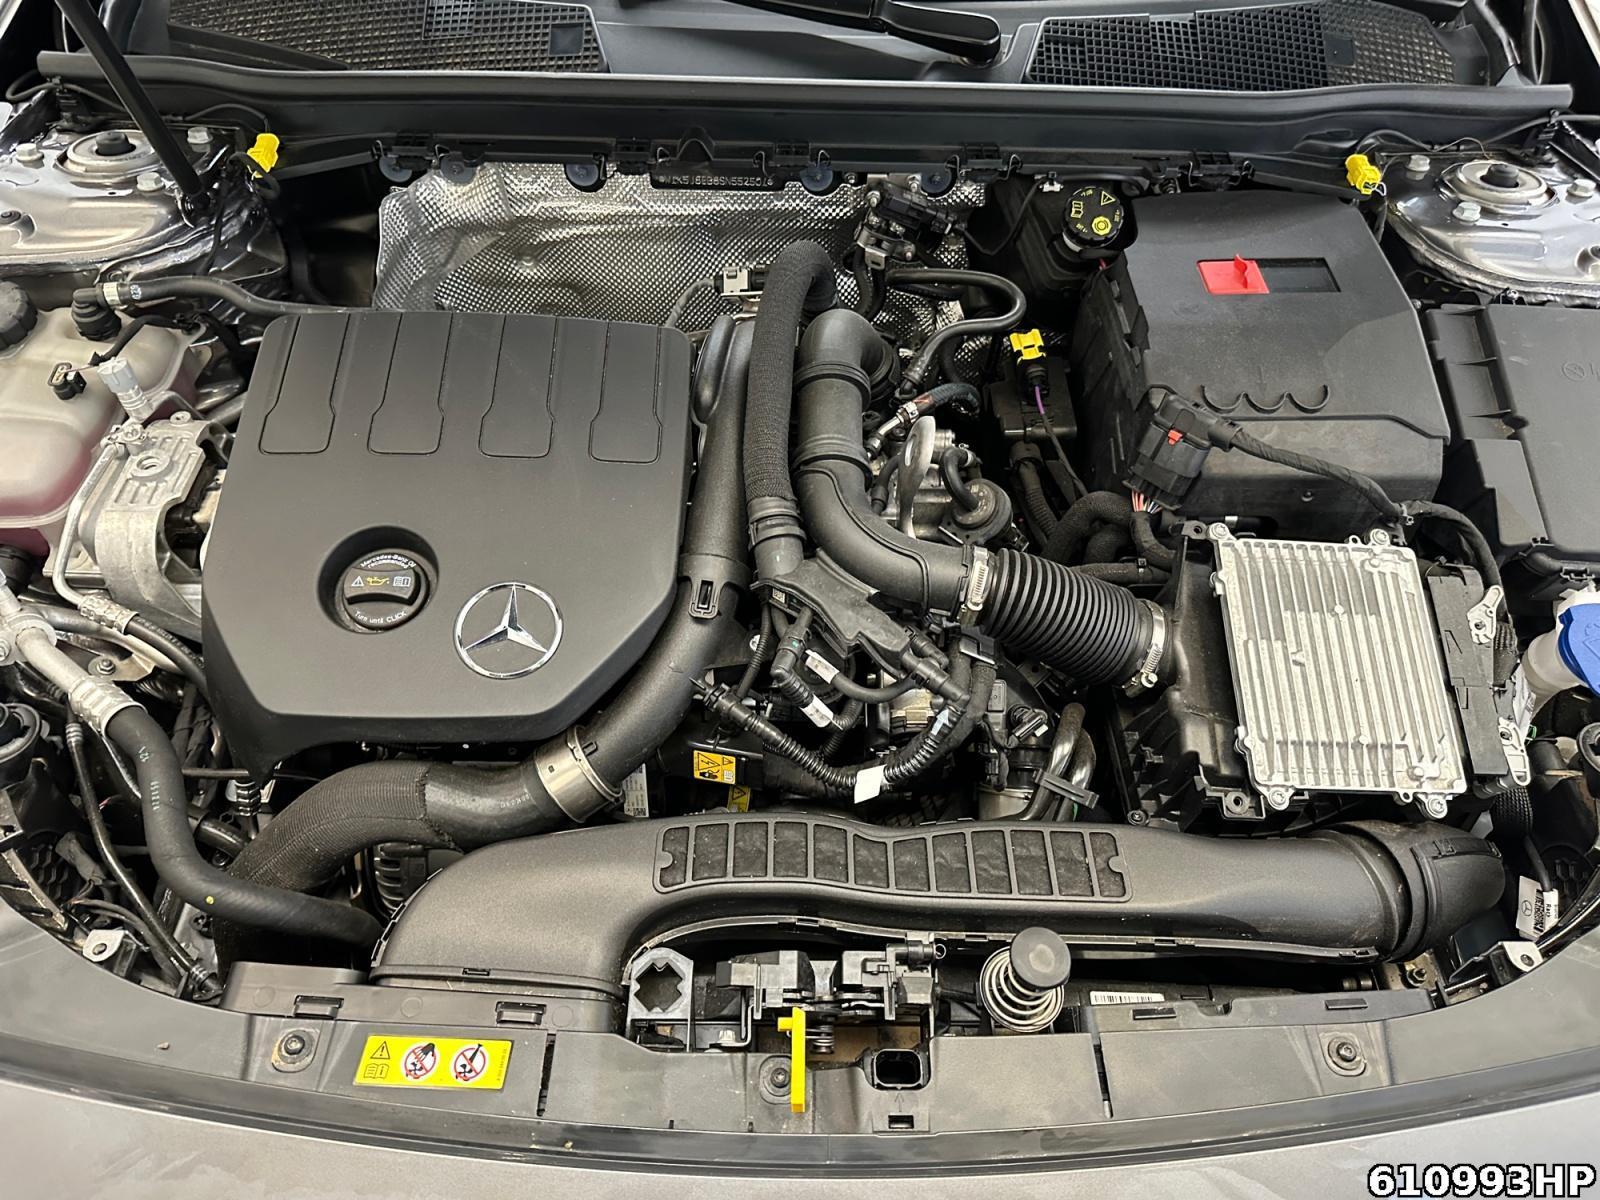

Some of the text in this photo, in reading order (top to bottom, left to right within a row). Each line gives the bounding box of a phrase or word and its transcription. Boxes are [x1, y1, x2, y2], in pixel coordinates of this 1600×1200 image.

[355, 610, 407, 624] Turn until CLICK
